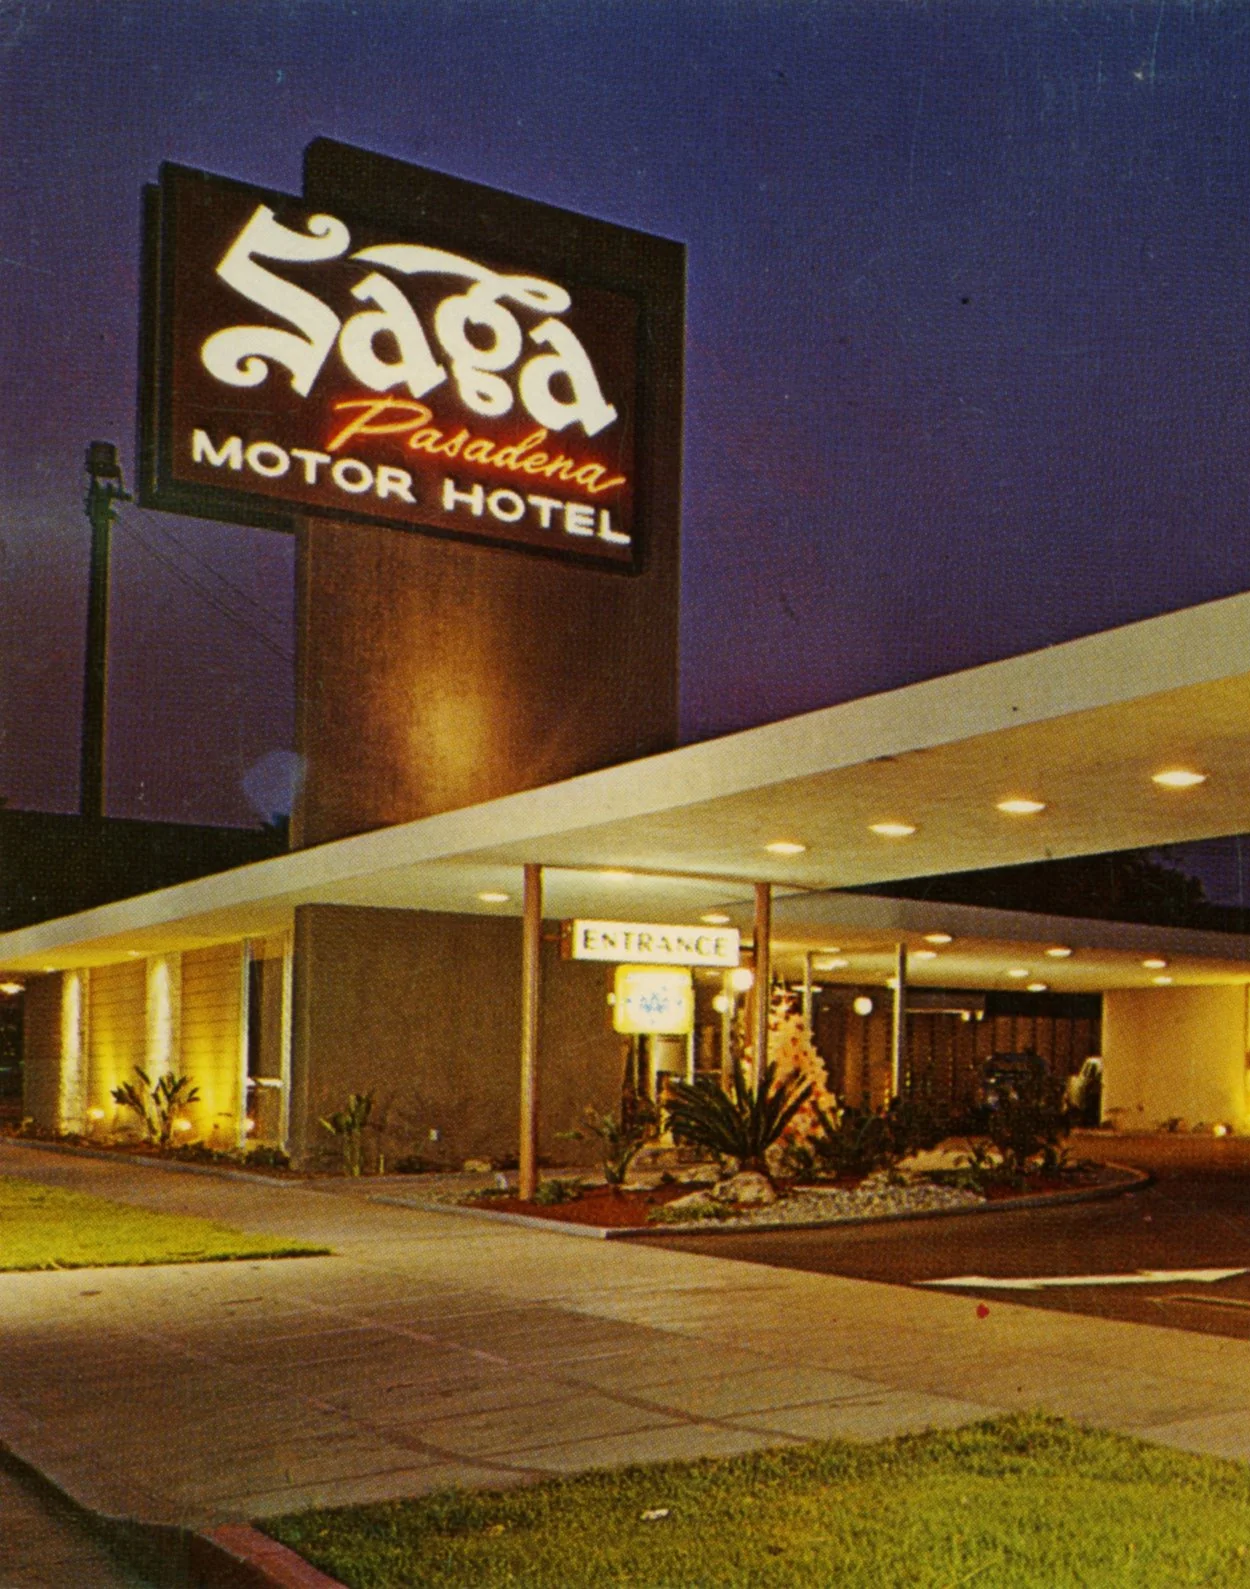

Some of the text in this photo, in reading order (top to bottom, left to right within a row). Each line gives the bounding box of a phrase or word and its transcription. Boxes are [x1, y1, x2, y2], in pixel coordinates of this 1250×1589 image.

[201, 203, 618, 438] Saga
[191, 428, 631, 545] MOTOR HOTEL
[326, 395, 626, 493] Pasadena
[583, 928, 729, 957] ENTRANCE
